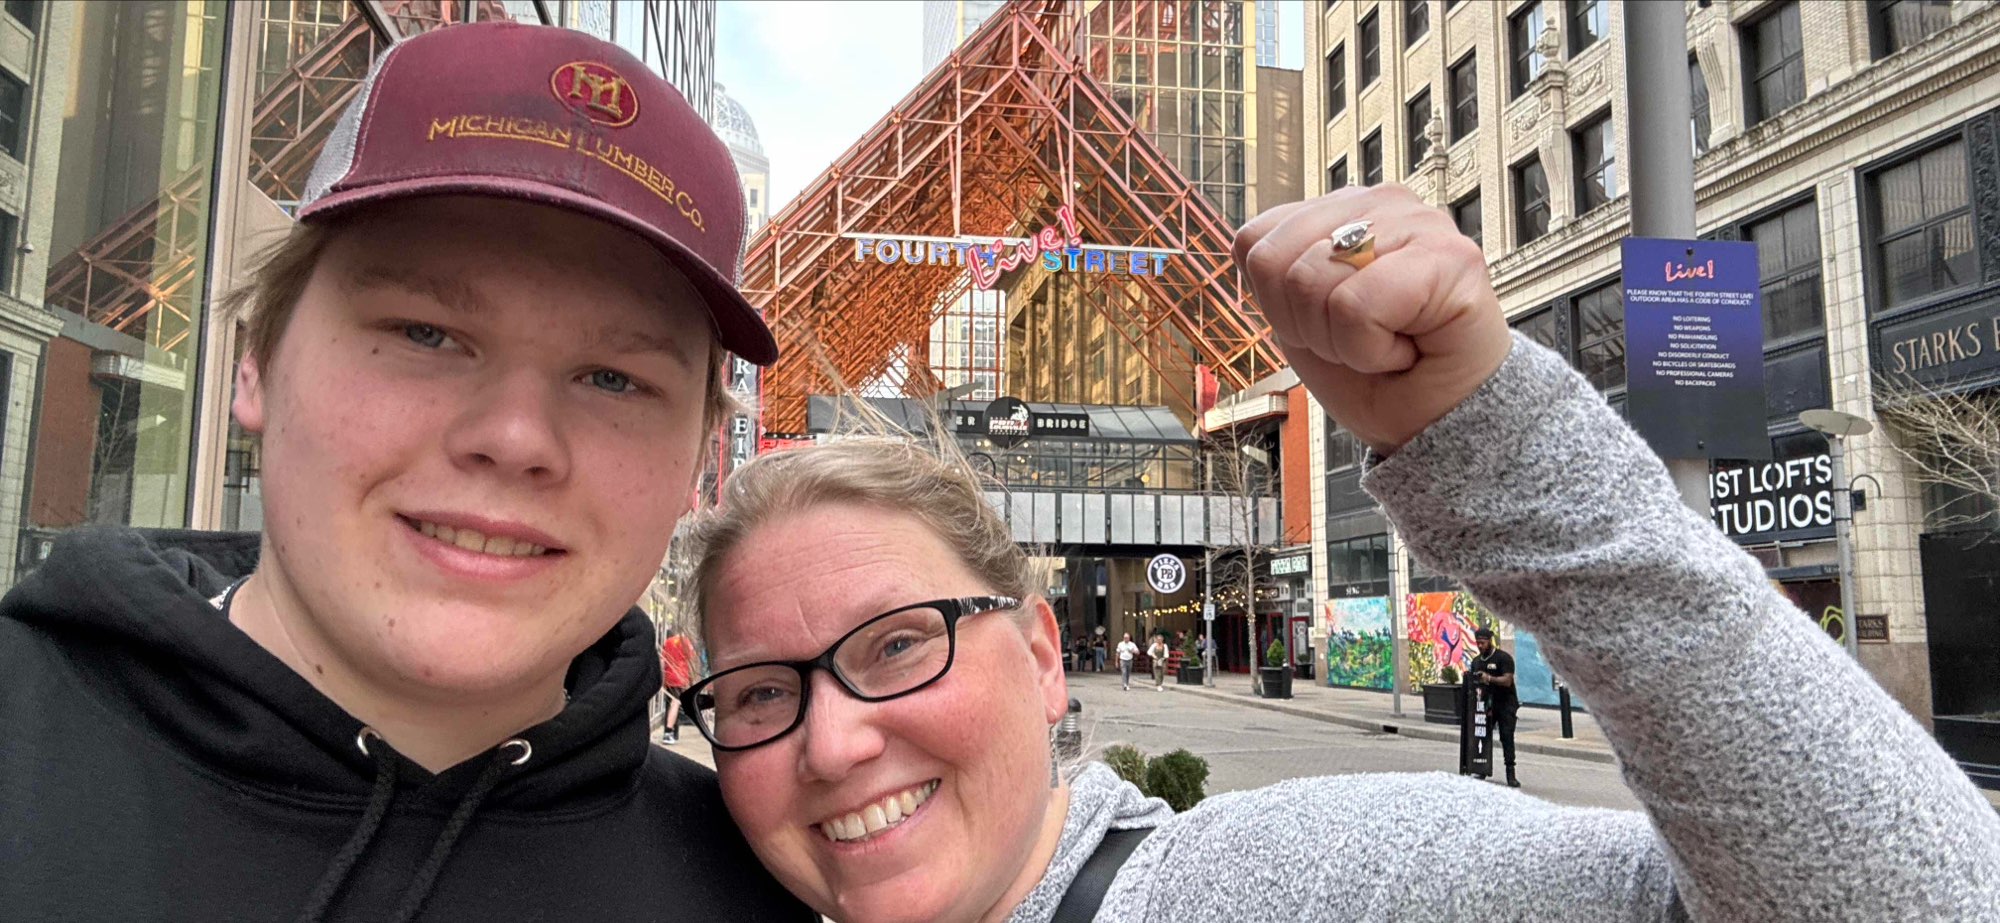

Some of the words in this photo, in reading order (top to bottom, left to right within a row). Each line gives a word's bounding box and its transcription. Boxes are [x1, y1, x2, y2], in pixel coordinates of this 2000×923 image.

[428, 114, 571, 146] MICHIGAN
[576, 129, 675, 198] LUMBER
[967, 205, 1082, 290] Live!
[1043, 247, 1169, 276] STREET
[1665, 260, 1714, 282] Live!
[1893, 322, 1981, 373] STARKS
[1037, 418, 1086, 429] BRIDGE
[1749, 454, 1832, 494] LOFTS
[1710, 490, 1832, 535] TUDIOS
[1153, 558, 1180, 571] PIZZA
[1161, 568, 1174, 580] PB
[1157, 581, 1177, 590] BAR
